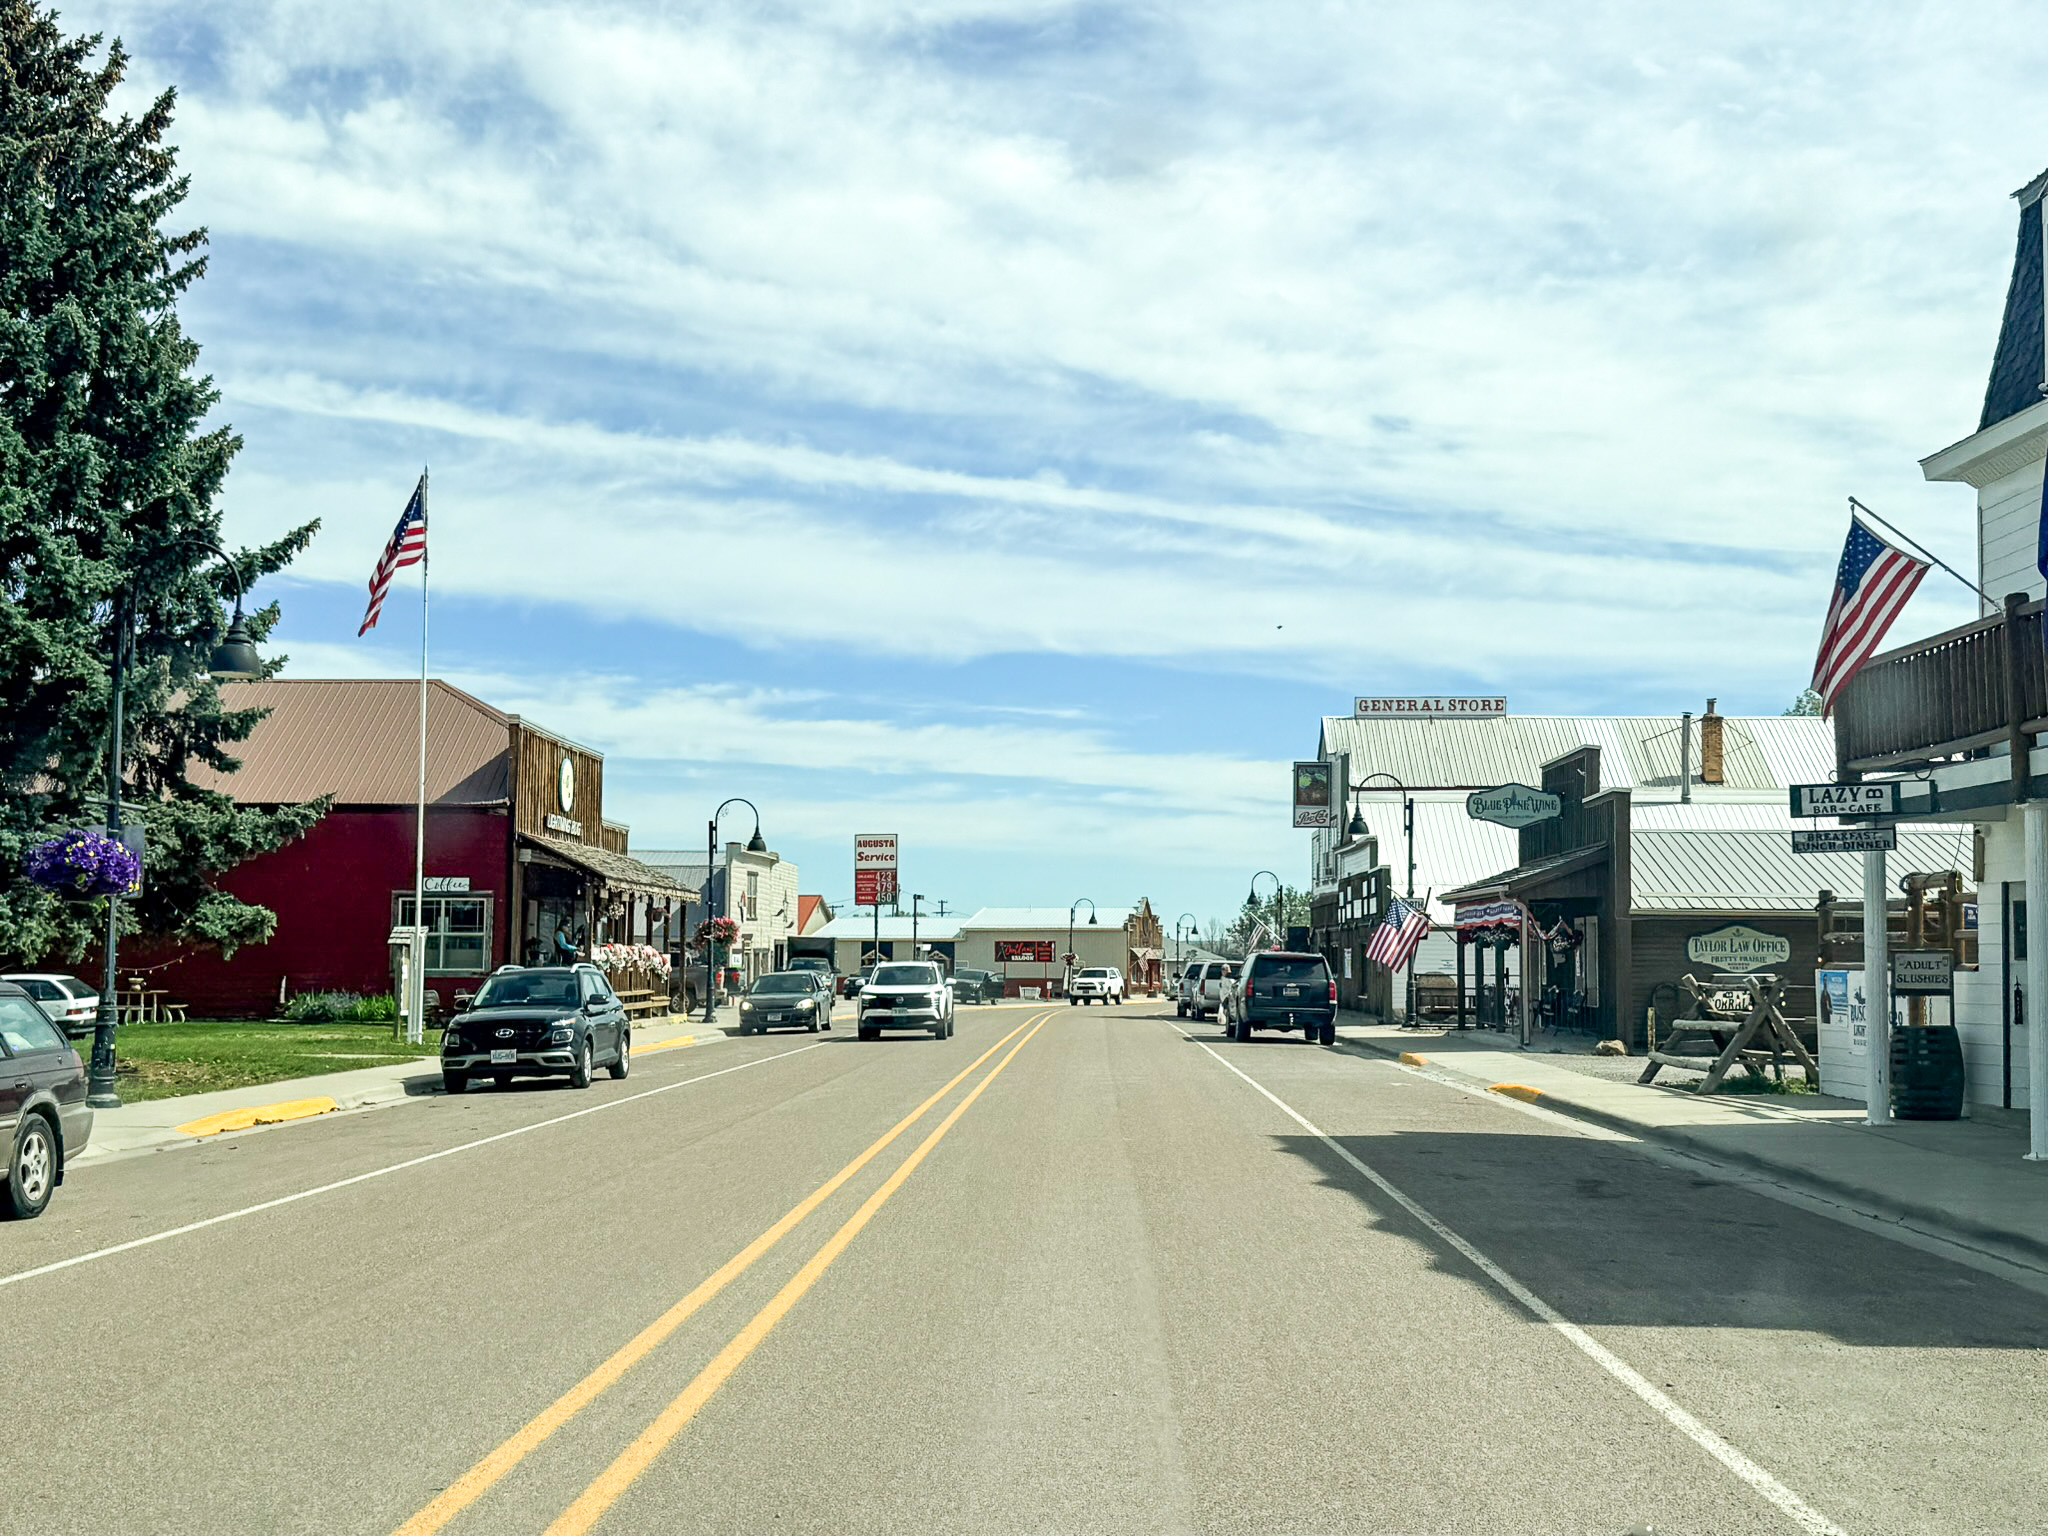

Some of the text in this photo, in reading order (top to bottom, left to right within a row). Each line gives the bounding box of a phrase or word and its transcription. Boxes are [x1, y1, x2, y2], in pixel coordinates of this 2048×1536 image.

[1359, 699, 1505, 712] GENERAL STORE
[1808, 787, 1862, 804] LAZY
[1813, 803, 1882, 814] BAR CAFE
[1807, 831, 1880, 842] BREAKFAST
[857, 839, 895, 848] AUGUSTA
[1795, 840, 1891, 852] LUNCH DINNER
[857, 851, 896, 862] Service
[876, 871, 893, 881] 423
[876, 882, 893, 892] 479
[875, 893, 892, 903] 450
[1692, 938, 1787, 954] TAYLOR LAW OFFICE
[1904, 960, 1942, 970] ADULT
[1896, 973, 1949, 984] SLUSHIES
[1712, 998, 1750, 1010] ORRAL
